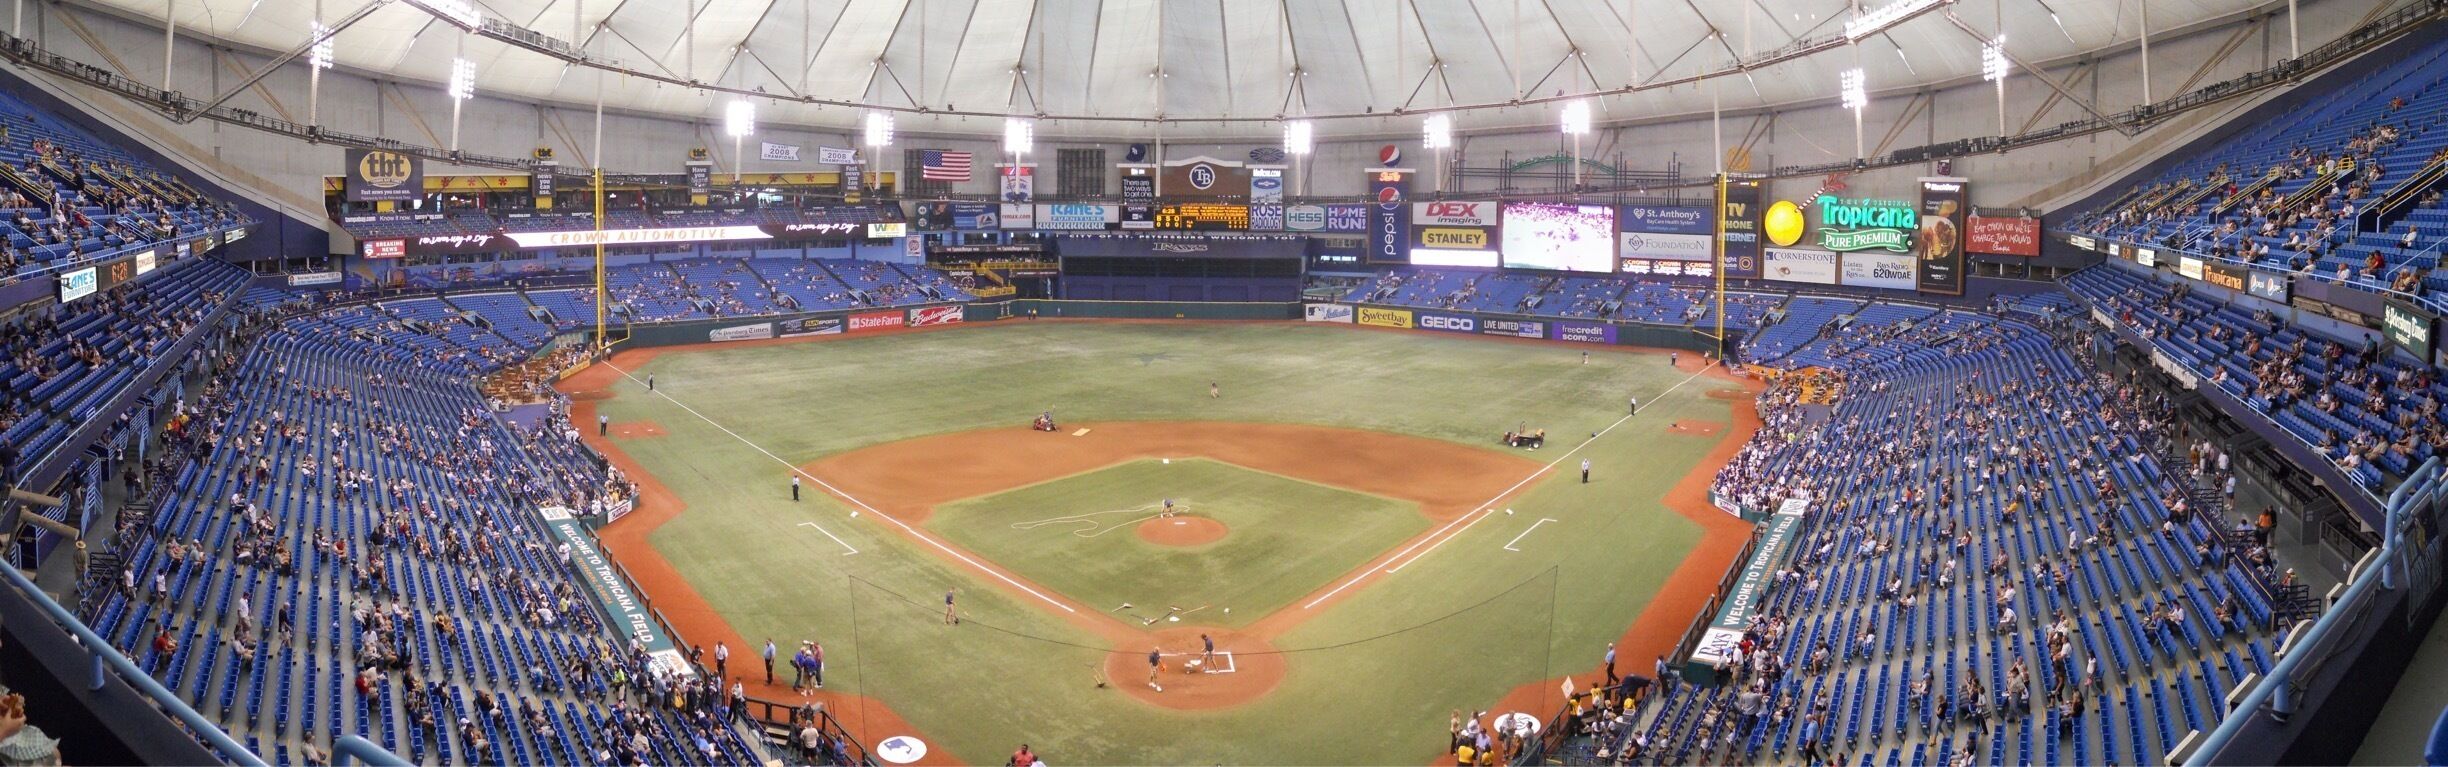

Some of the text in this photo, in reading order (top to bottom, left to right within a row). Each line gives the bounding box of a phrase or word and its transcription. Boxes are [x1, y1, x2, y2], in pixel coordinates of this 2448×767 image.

[538, 148, 552, 157] tbt
[367, 152, 405, 177] tbt
[1252, 204, 1281, 216] ROSE
[1425, 202, 1480, 217] DEX
[1660, 210, 1701, 221] Anthony's
[1727, 203, 1746, 217] TV
[1817, 195, 1915, 229] Tropicana
[1252, 217, 1281, 229] RADIOLOGY
[1289, 213, 1322, 222] HESS
[1328, 218, 1366, 229] RUN!
[1437, 216, 1482, 225] imaging
[1724, 220, 1752, 229] HONE
[1974, 225, 1986, 233] EAT
[2005, 223, 2014, 231] OR
[550, 229, 726, 245] CROWN AUTOMOTIVE
[1384, 212, 1397, 255] pepsi
[1427, 233, 1481, 244] STANLEY
[1717, 233, 1756, 242] ITERNET
[1972, 234, 1995, 242] CHARGE
[2009, 234, 2031, 244] MOUND
[1646, 239, 1705, 250] FOUNDATION
[1825, 232, 1901, 248] PURE PREMIUM
[1774, 251, 1836, 265] CORNERSTONE
[111, 262, 128, 283] 6:28
[2203, 264, 2242, 290] Tropicana
[64, 285, 95, 302] FURNITURE
[914, 307, 957, 324] Budweiser
[1362, 308, 1407, 324] Sweetbay
[1421, 315, 1473, 331] GEICO
[1484, 320, 1519, 331] LIVE UNITED
[749, 327, 769, 335] Times
[1562, 325, 1603, 335] freecredit
[1562, 333, 1605, 343] score.com
[1723, 516, 1795, 625] WELCOME TO TROPICANA FIELD
[559, 523, 655, 643] WELCOME TO TROPICANA FIELD
